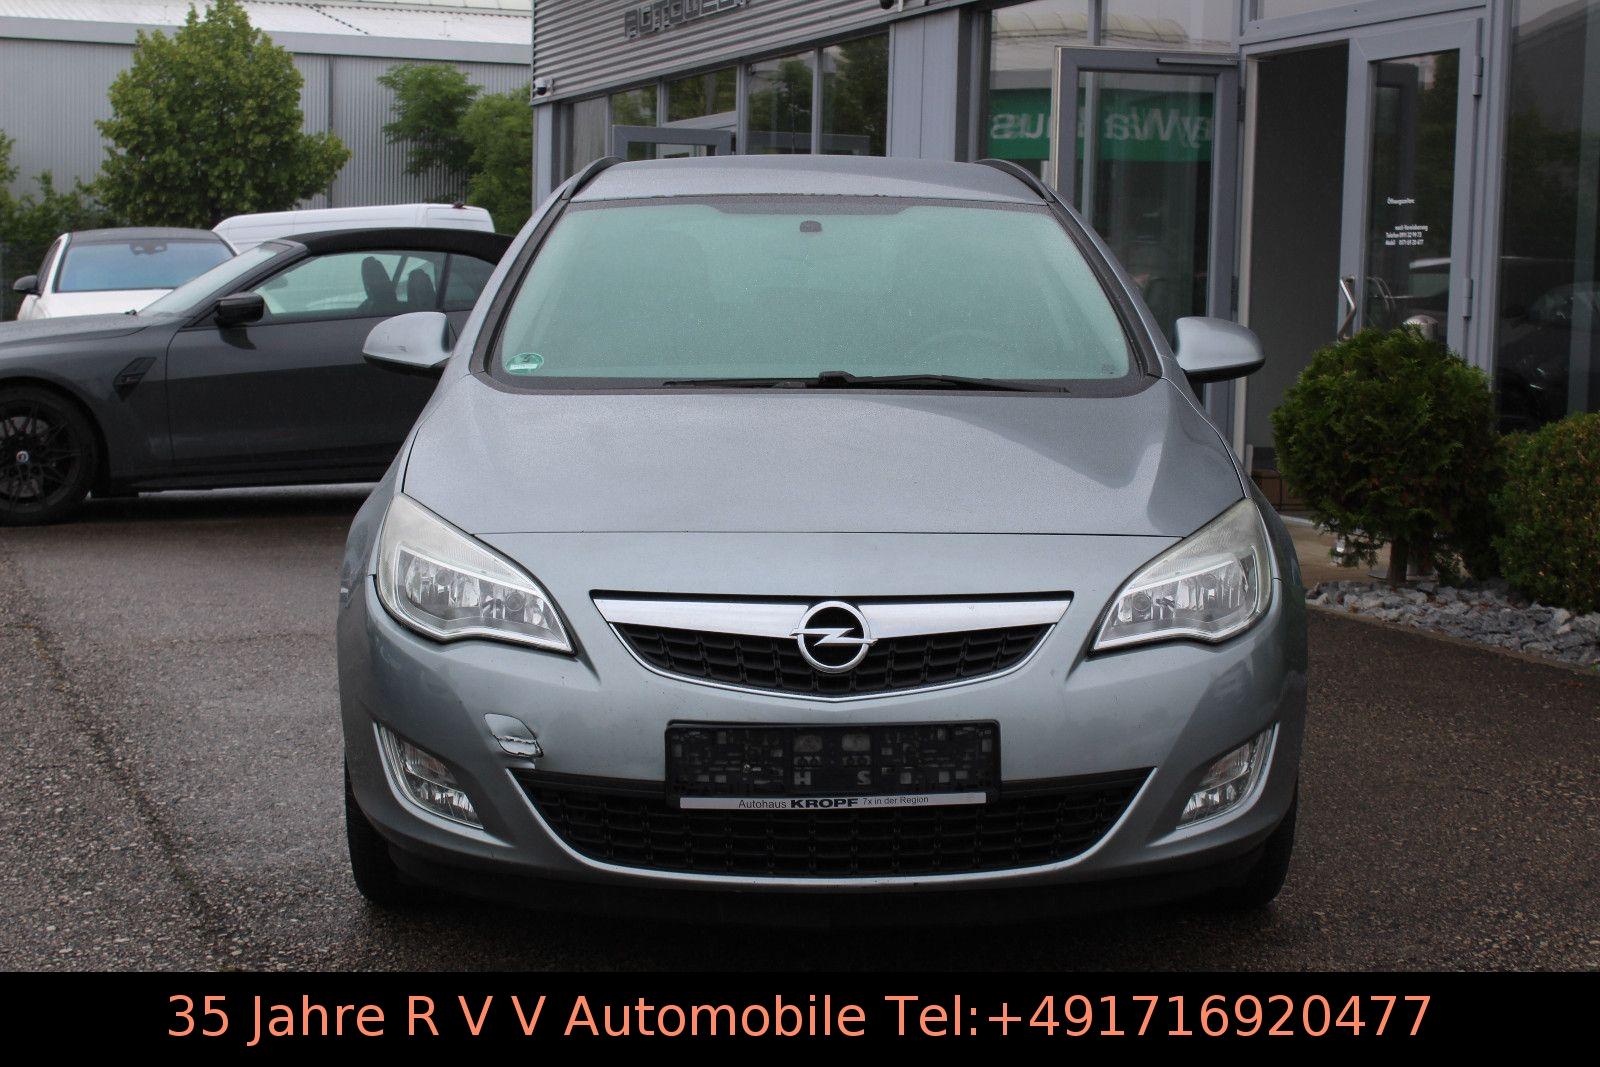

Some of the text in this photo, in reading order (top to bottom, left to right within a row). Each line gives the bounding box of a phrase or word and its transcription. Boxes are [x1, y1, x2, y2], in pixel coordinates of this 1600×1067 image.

[738, 795, 930, 809] Autohaus KROPF 7x in der Region
